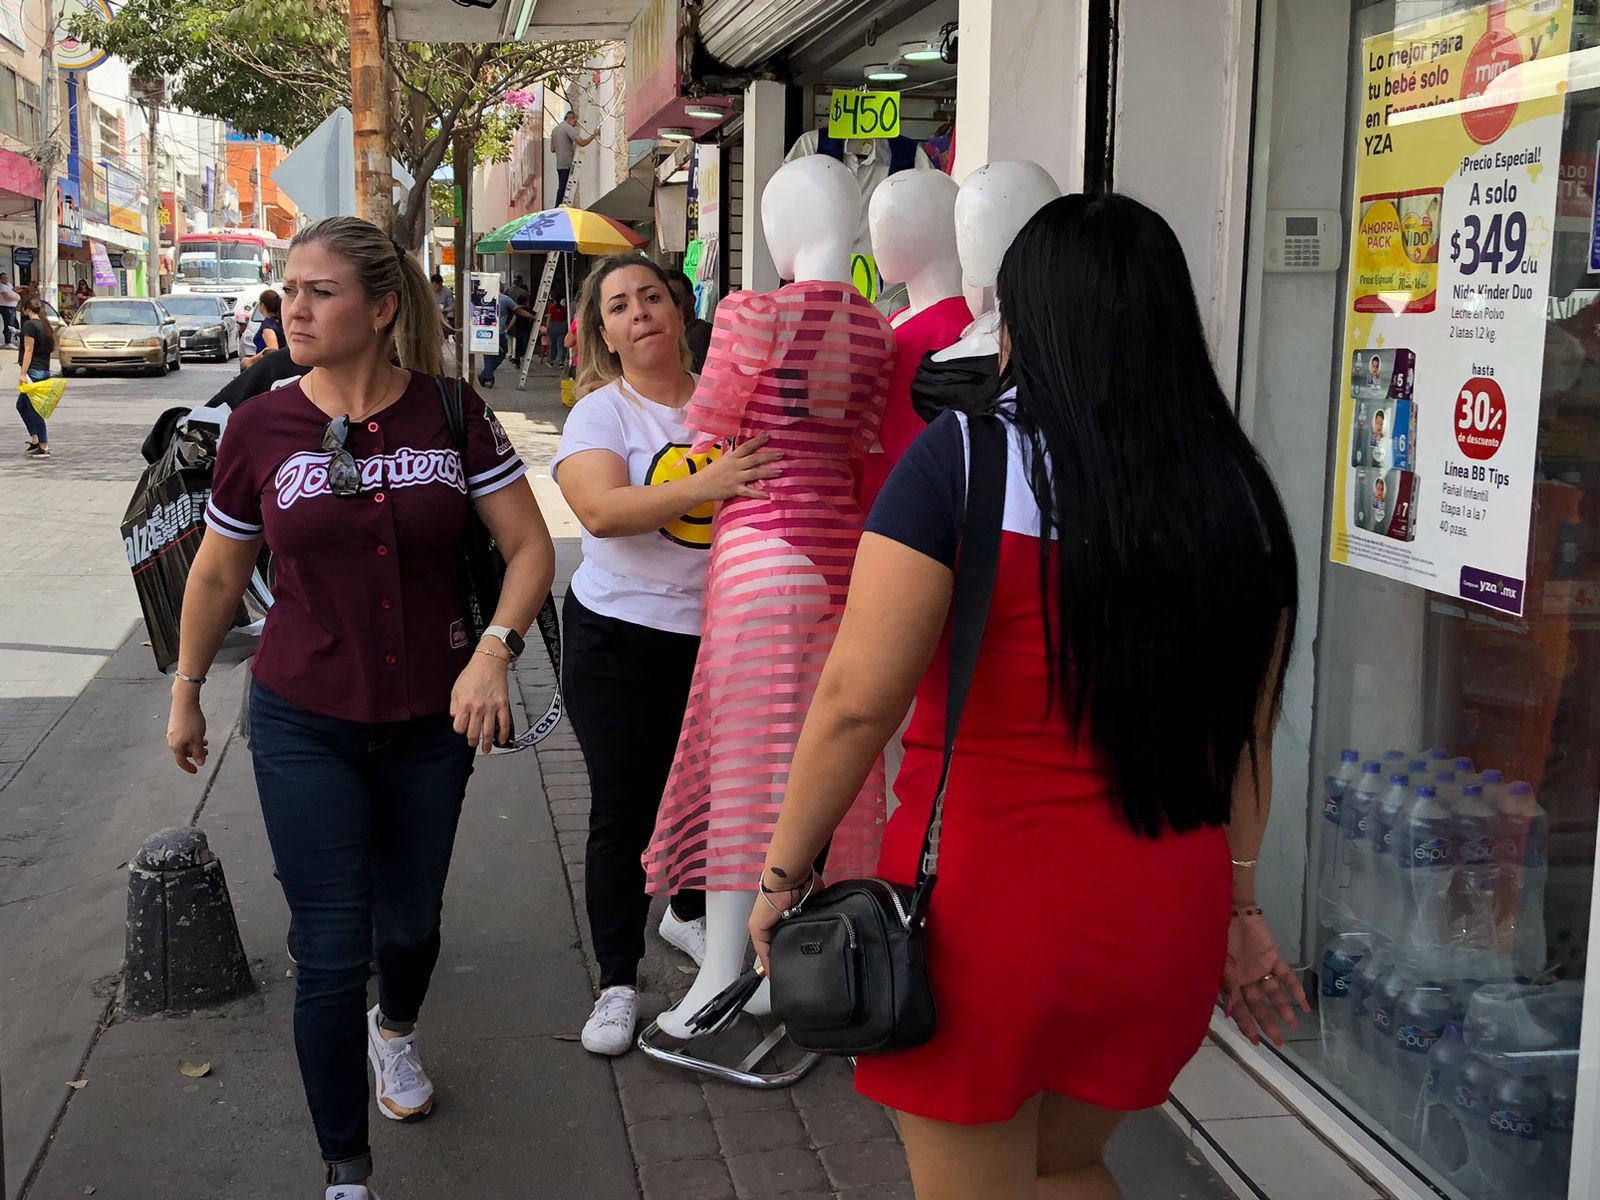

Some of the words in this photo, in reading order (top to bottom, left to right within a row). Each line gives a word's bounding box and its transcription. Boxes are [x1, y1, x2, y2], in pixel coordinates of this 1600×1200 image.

[1369, 52, 1384, 72] Lo
[1388, 42, 1427, 68] mejor
[1431, 34, 1464, 63] para
[1368, 82, 1381, 101] tu
[1384, 71, 1417, 96] bebé
[1420, 64, 1449, 89] solo
[831, 94, 898, 135] $450
[1366, 111, 1380, 128] en
[1364, 132, 1393, 156] YZA
[1460, 154, 1492, 177] ¡Precio
[1495, 146, 1541, 171] Especial!
[1469, 182, 1480, 206] A
[1485, 178, 1517, 205] solo
[1361, 221, 1399, 234] AHORRA
[1367, 236, 1392, 248] PACK
[1450, 211, 1527, 275] $349
[1521, 255, 1538, 274] c/u
[1478, 283, 1510, 300] Kinder
[1511, 284, 1533, 300] Duo
[1451, 307, 1472, 319] Leche
[1484, 307, 1505, 320] Polvo
[1449, 326, 1455, 338] 2
[1455, 325, 1474, 339] latas
[1472, 362, 1495, 376] hasta
[1458, 389, 1503, 432] 30%
[1457, 432, 1466, 443] de
[1466, 433, 1500, 448] descuento
[275, 447, 468, 509] Toateros
[1444, 460, 1469, 479] Línea
[1472, 465, 1485, 481] BB
[1488, 468, 1510, 489] Tips
[1442, 481, 1462, 498] Pañal
[1463, 486, 1489, 502] Infantil
[1440, 500, 1461, 517] Etapa
[1473, 508, 1481, 520] la
[1481, 509, 1487, 521] 7
[1439, 519, 1449, 532] 40
[1449, 523, 1469, 538] pzas.
